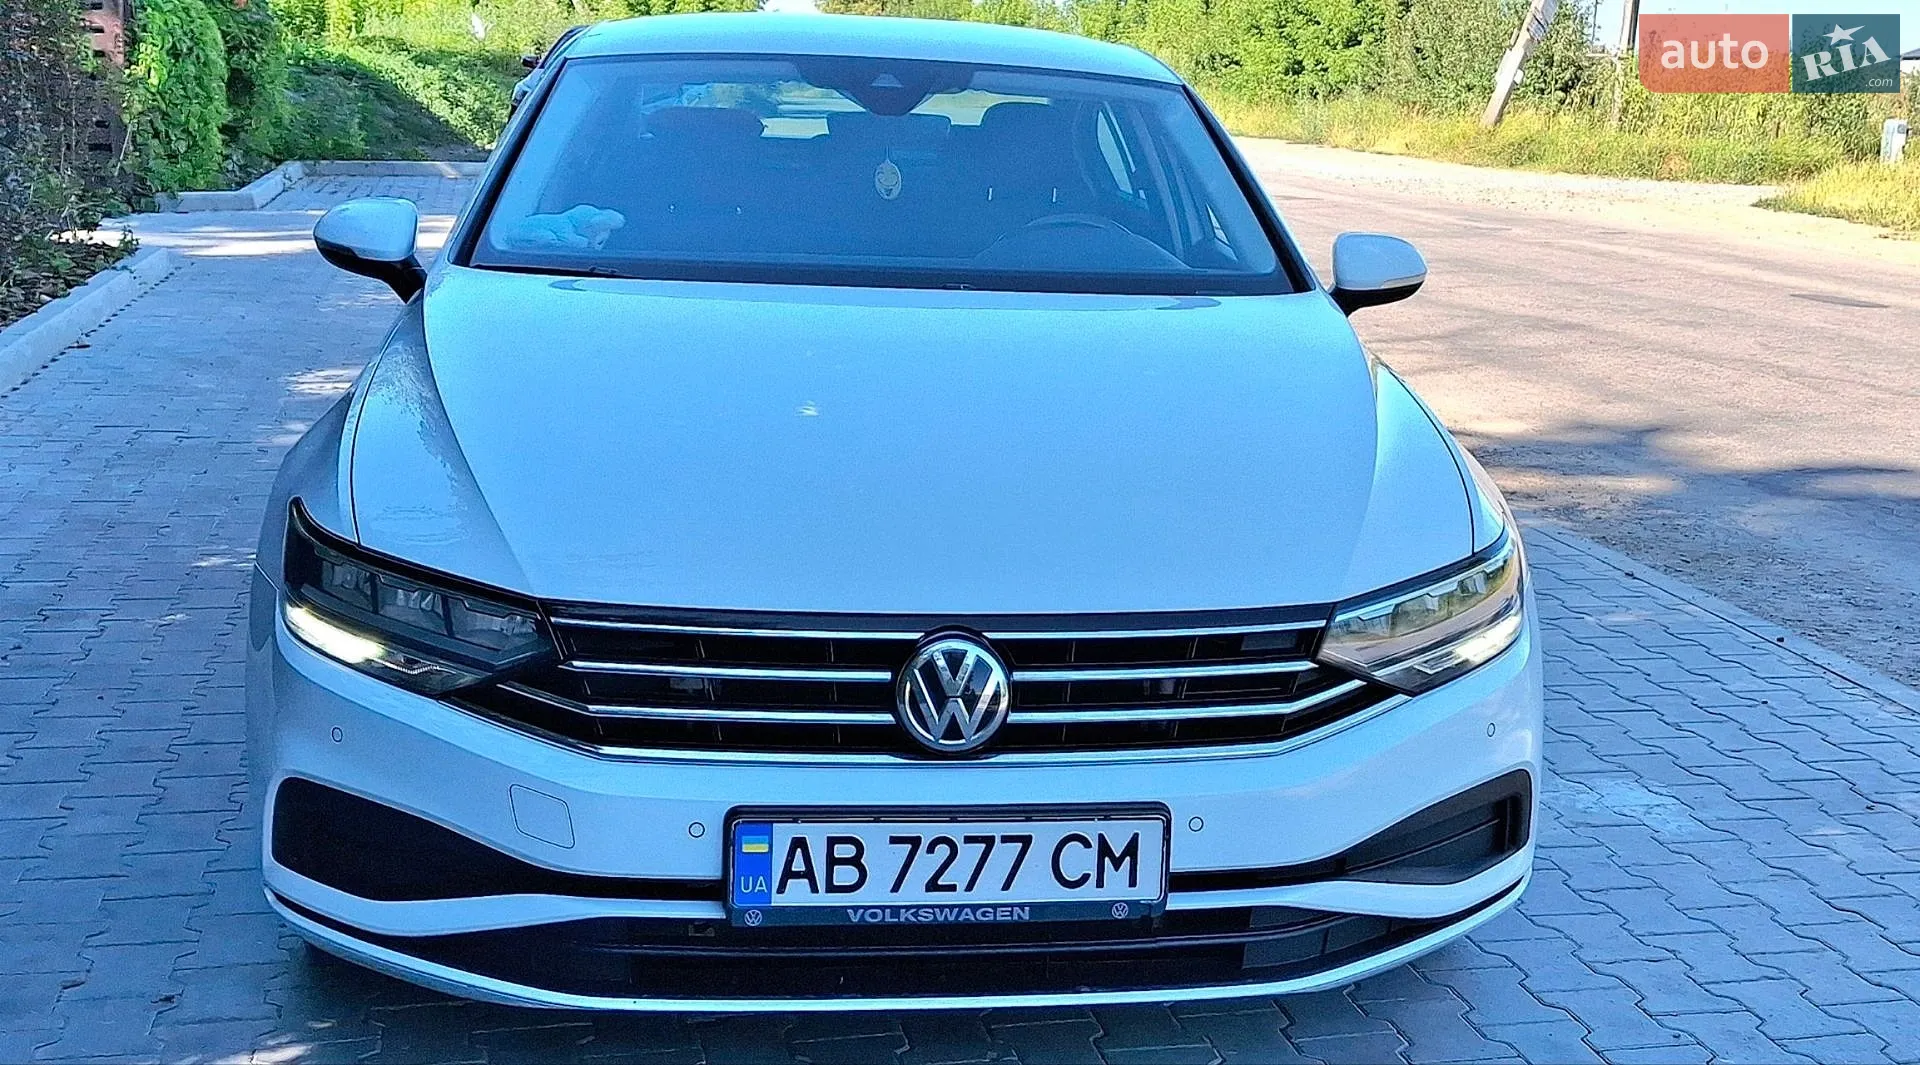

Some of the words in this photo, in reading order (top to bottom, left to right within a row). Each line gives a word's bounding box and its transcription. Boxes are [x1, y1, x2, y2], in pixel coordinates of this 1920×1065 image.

[776, 834, 868, 894] AB
[889, 834, 1033, 893] 7277
[1051, 832, 1139, 890] CM
[740, 875, 768, 893] UA
[847, 906, 1030, 923] VOLKSWAGEN
